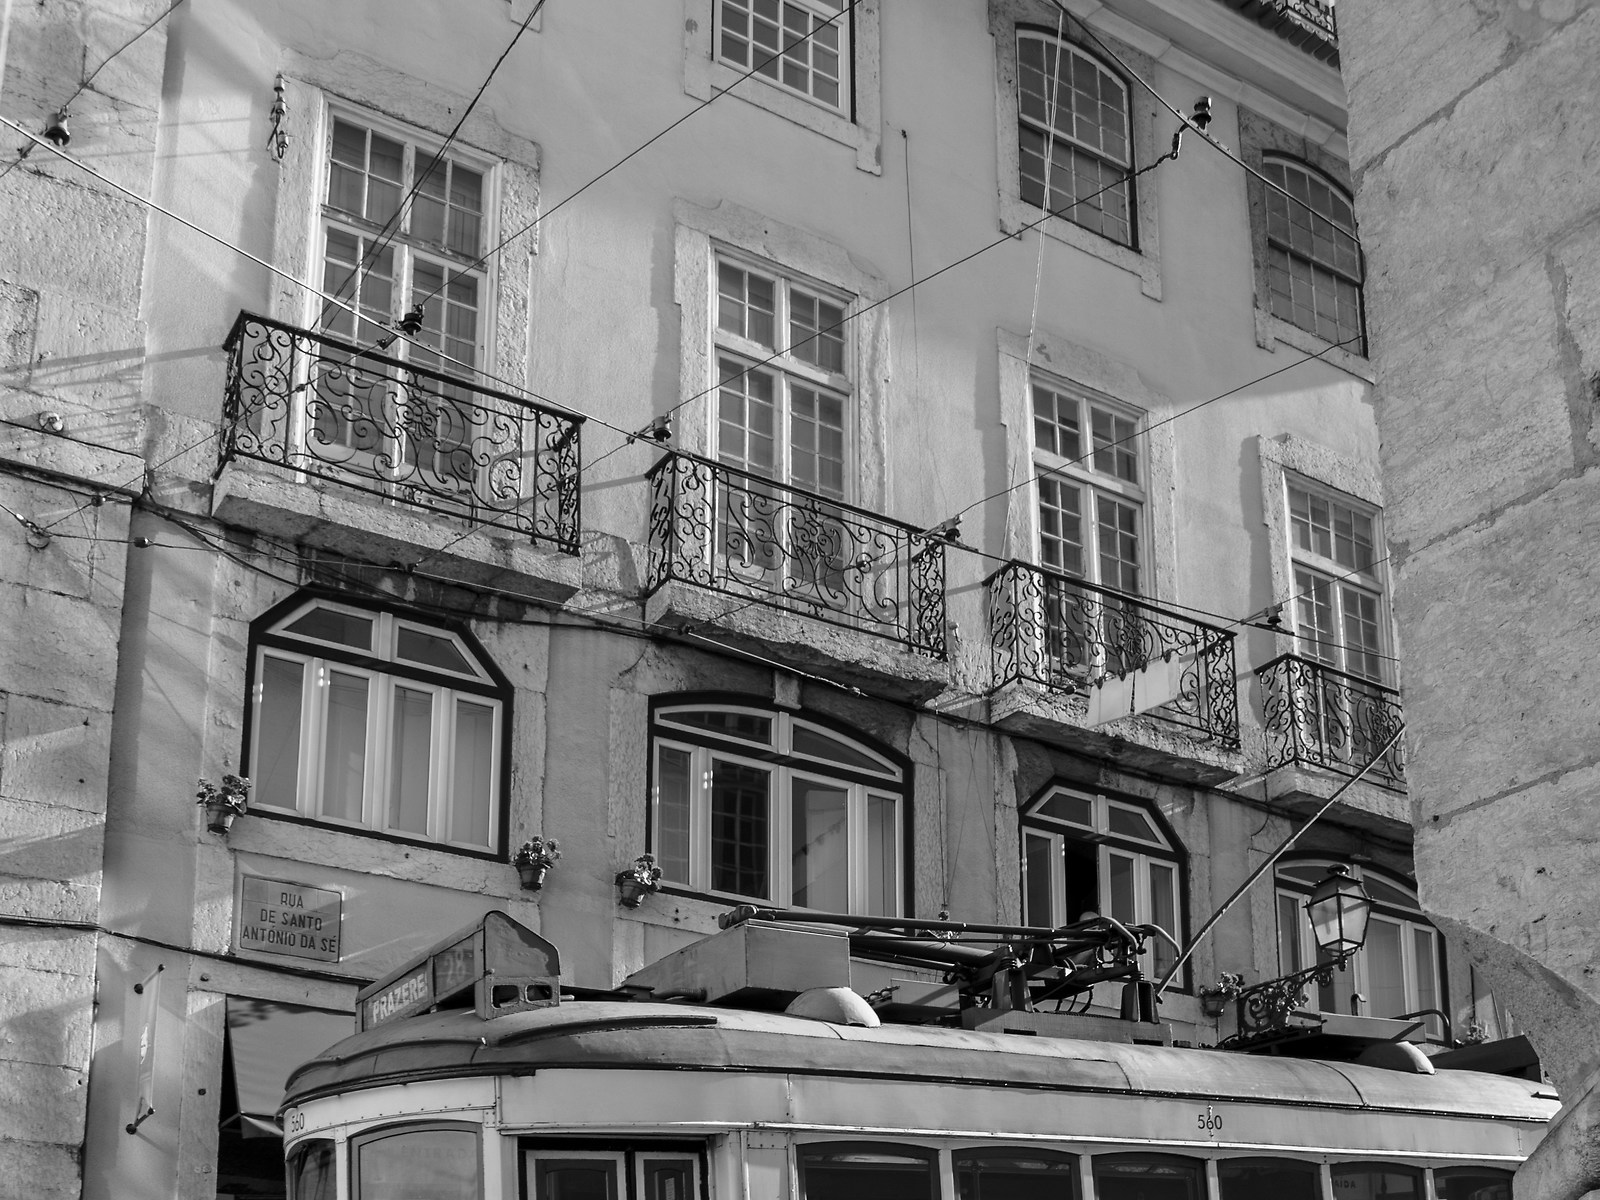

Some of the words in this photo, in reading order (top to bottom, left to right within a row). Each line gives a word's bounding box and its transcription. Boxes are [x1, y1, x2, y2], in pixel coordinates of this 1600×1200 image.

[280, 892, 304, 909] RUA
[260, 908, 276, 924] DE
[281, 912, 323, 931] SANTO
[242, 925, 297, 947] ANTÓNIO
[300, 933, 316, 950] DA
[320, 935, 337, 953] SÉ
[372, 971, 428, 1024] PRAZERE
[291, 1112, 305, 1133] 560
[1197, 1114, 1223, 1130] 560
[1334, 1176, 1357, 1189] AÍDA
